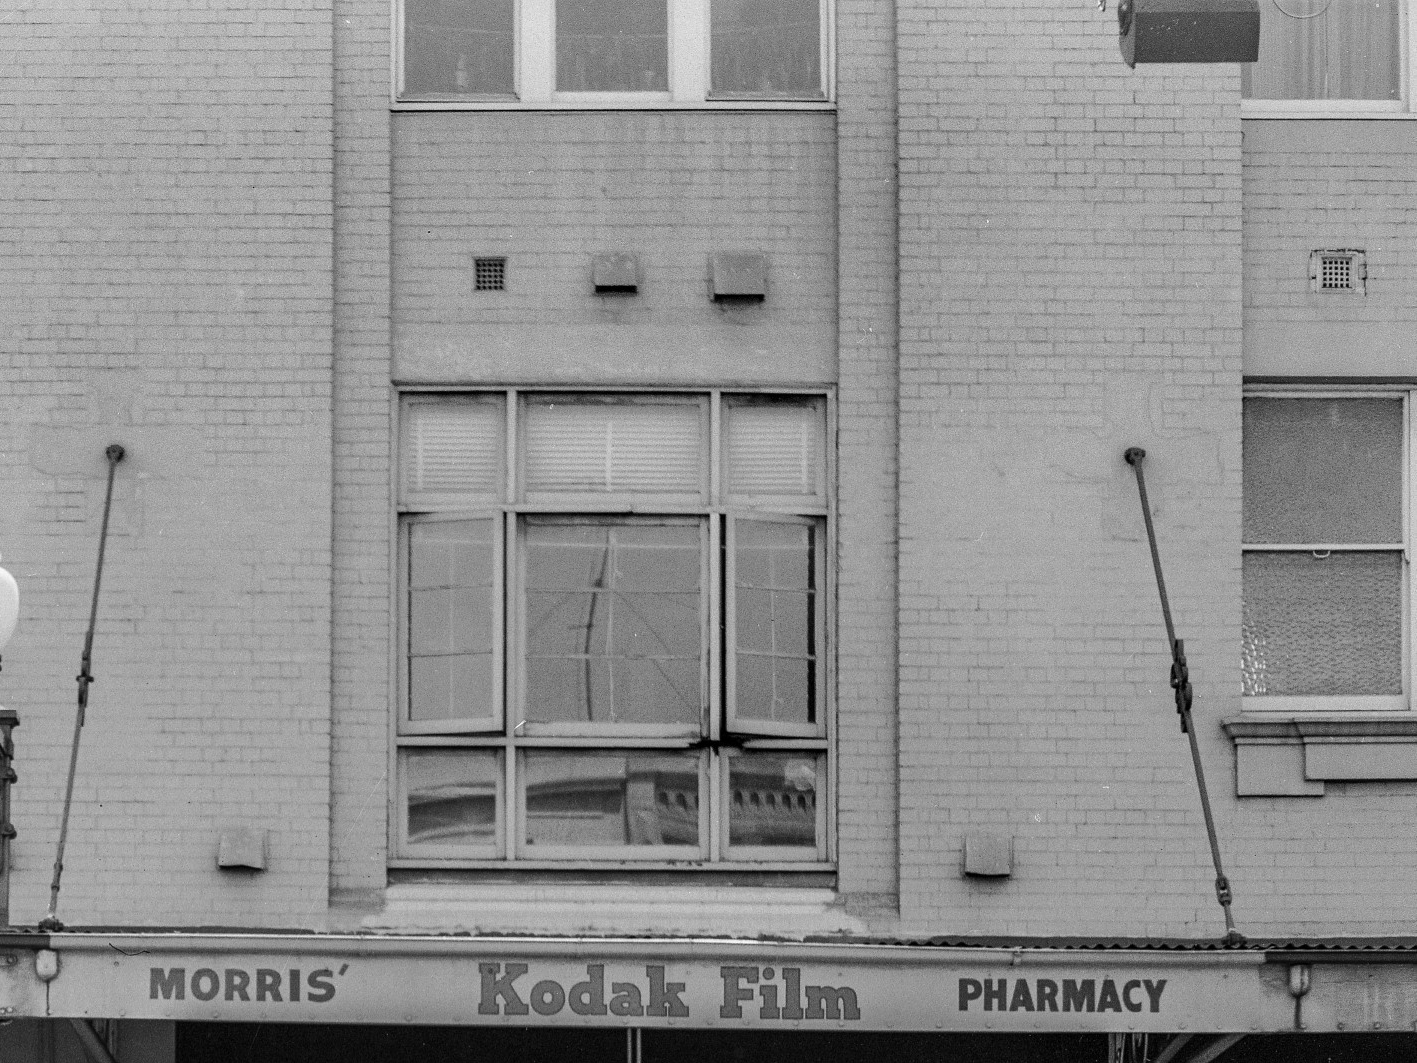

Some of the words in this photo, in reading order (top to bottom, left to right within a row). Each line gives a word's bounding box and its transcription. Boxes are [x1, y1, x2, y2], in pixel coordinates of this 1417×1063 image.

[149, 964, 349, 1003] MORRIS'
[478, 962, 690, 1018] Kodak
[719, 965, 861, 1020] Film
[958, 977, 1168, 1014] PHARMACY
